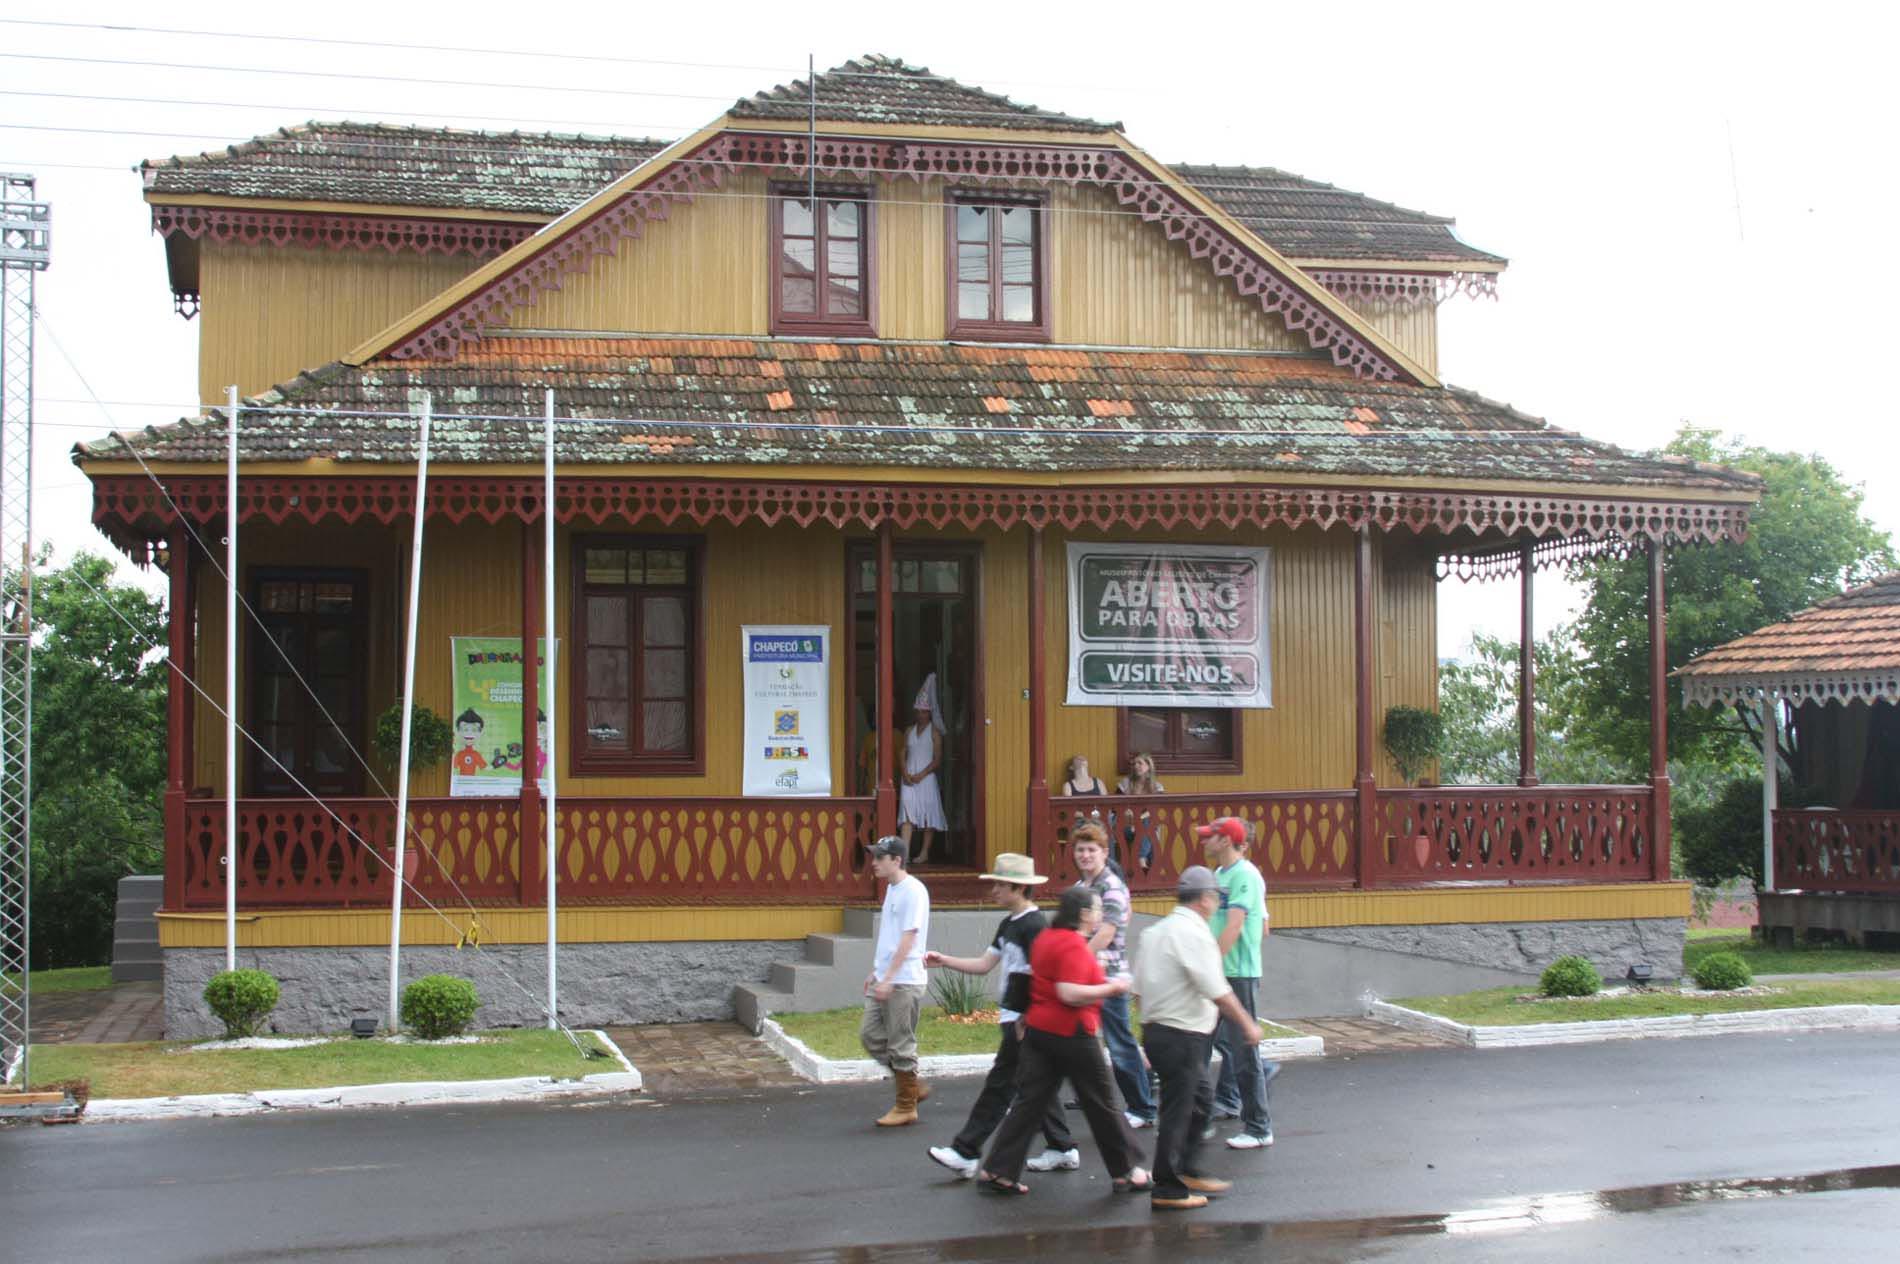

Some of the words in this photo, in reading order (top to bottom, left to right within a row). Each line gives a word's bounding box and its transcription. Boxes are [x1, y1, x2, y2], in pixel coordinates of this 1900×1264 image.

[1100, 580, 1240, 610] ABERTO
[1099, 610, 1158, 626] PARA
[1166, 611, 1240, 629] OBRAS
[753, 640, 799, 652] CHAPECÓ
[1106, 663, 1233, 684] VISITE-NOS
